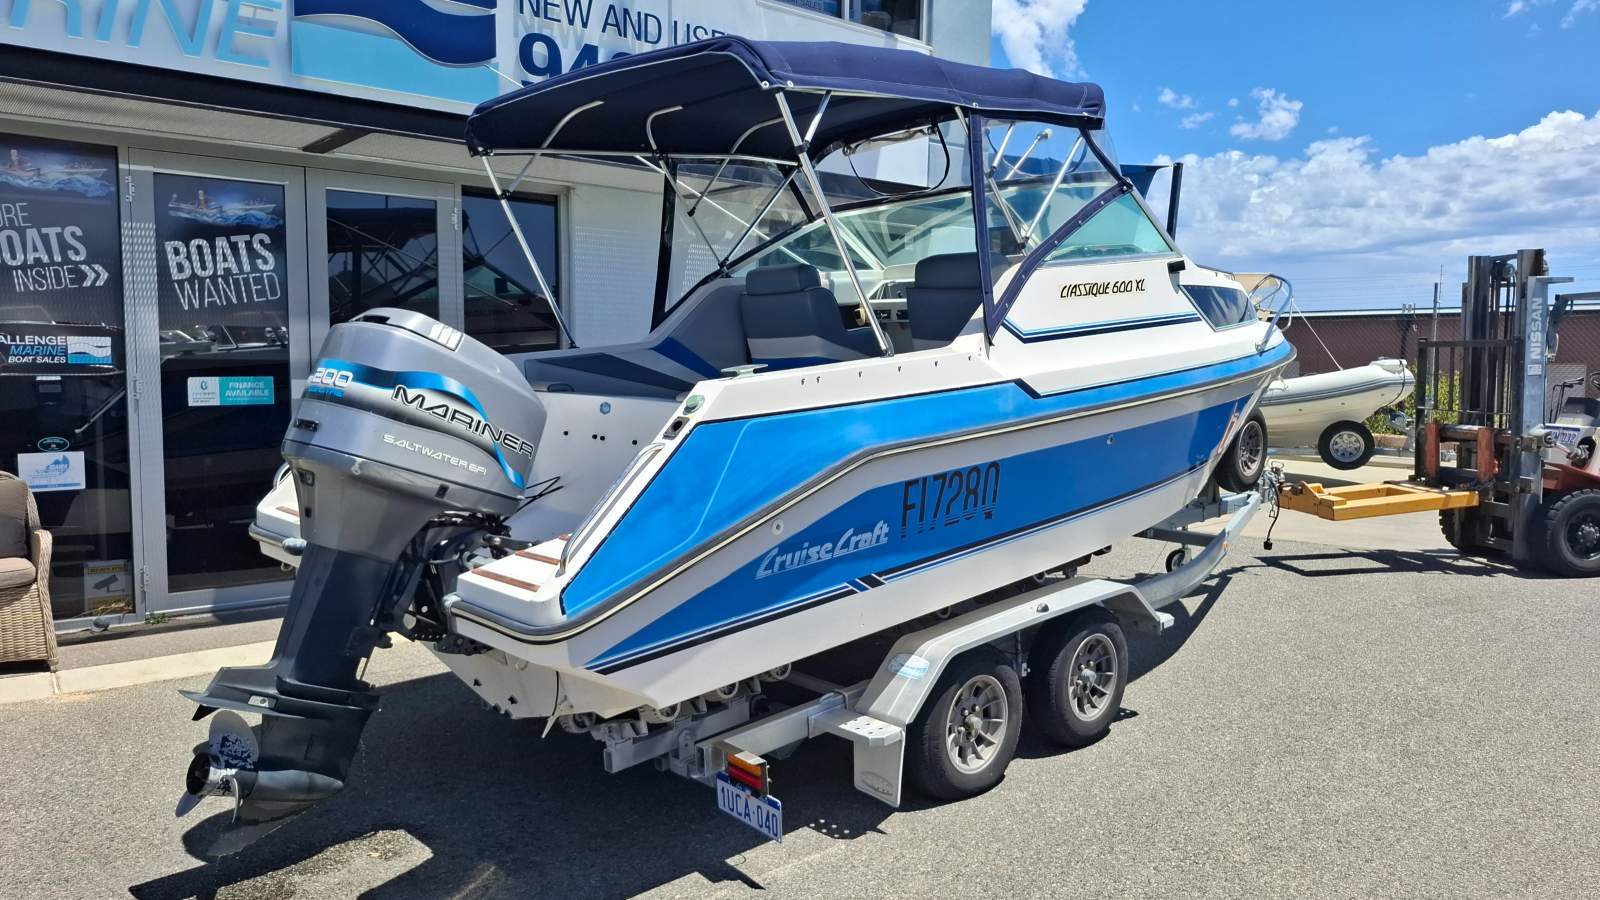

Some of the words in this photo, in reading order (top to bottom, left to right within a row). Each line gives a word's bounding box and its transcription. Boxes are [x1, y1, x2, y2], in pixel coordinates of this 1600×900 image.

[601, 4, 662, 45] AND
[164, 233, 276, 280] BOATS
[13, 265, 79, 292] INSIDE
[173, 272, 281, 311] WANTED
[1111, 280, 1133, 294] 600
[1135, 279, 1146, 292] XL
[1530, 297, 1543, 360] NISSAN
[9, 345, 66, 356] MARINE
[225, 389, 270, 397] AVAILABLE
[307, 367, 353, 387] 200
[391, 384, 534, 459] MARINER
[383, 434, 468, 469] SALTWATER
